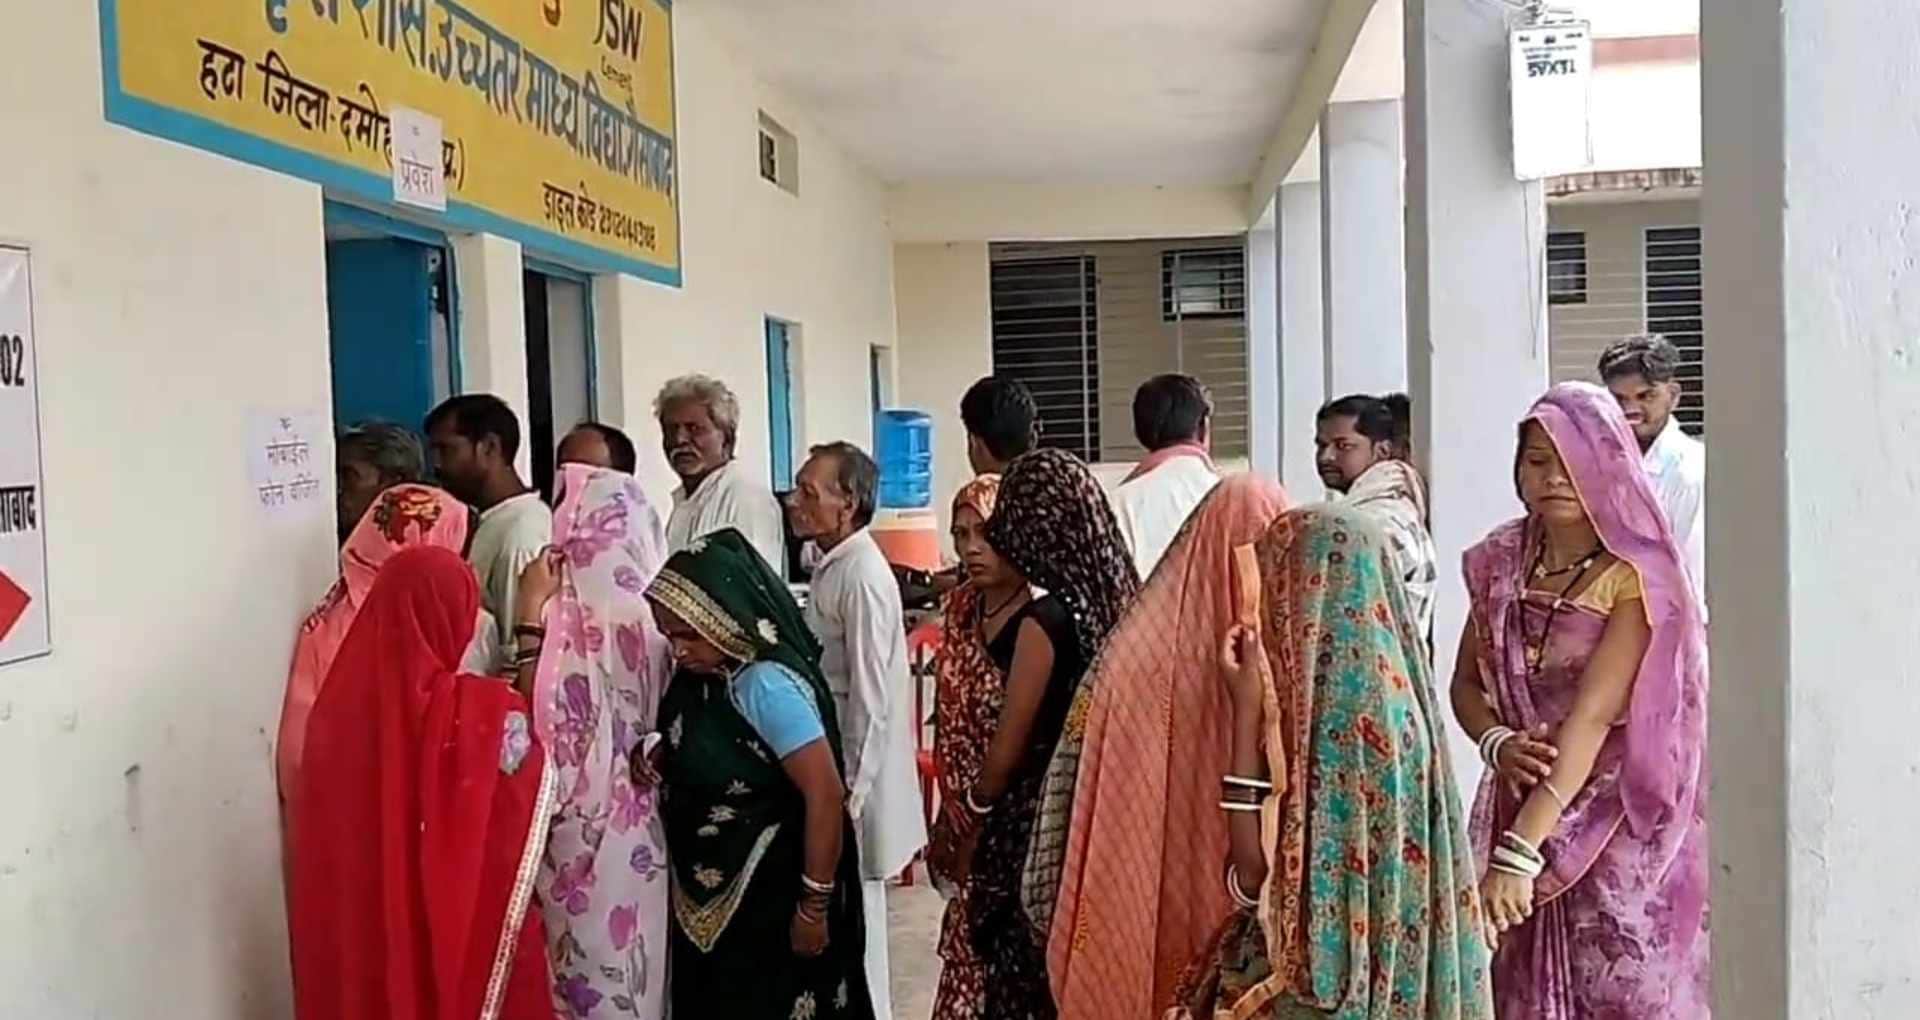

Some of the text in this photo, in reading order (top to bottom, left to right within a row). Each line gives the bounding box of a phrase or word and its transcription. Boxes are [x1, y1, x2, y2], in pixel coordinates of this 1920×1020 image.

[592, 0, 642, 62] JSW
[197, 38, 246, 101] हटा
[1527, 59, 1577, 77] TEXAS
[400, 150, 434, 195] प्रवेश
